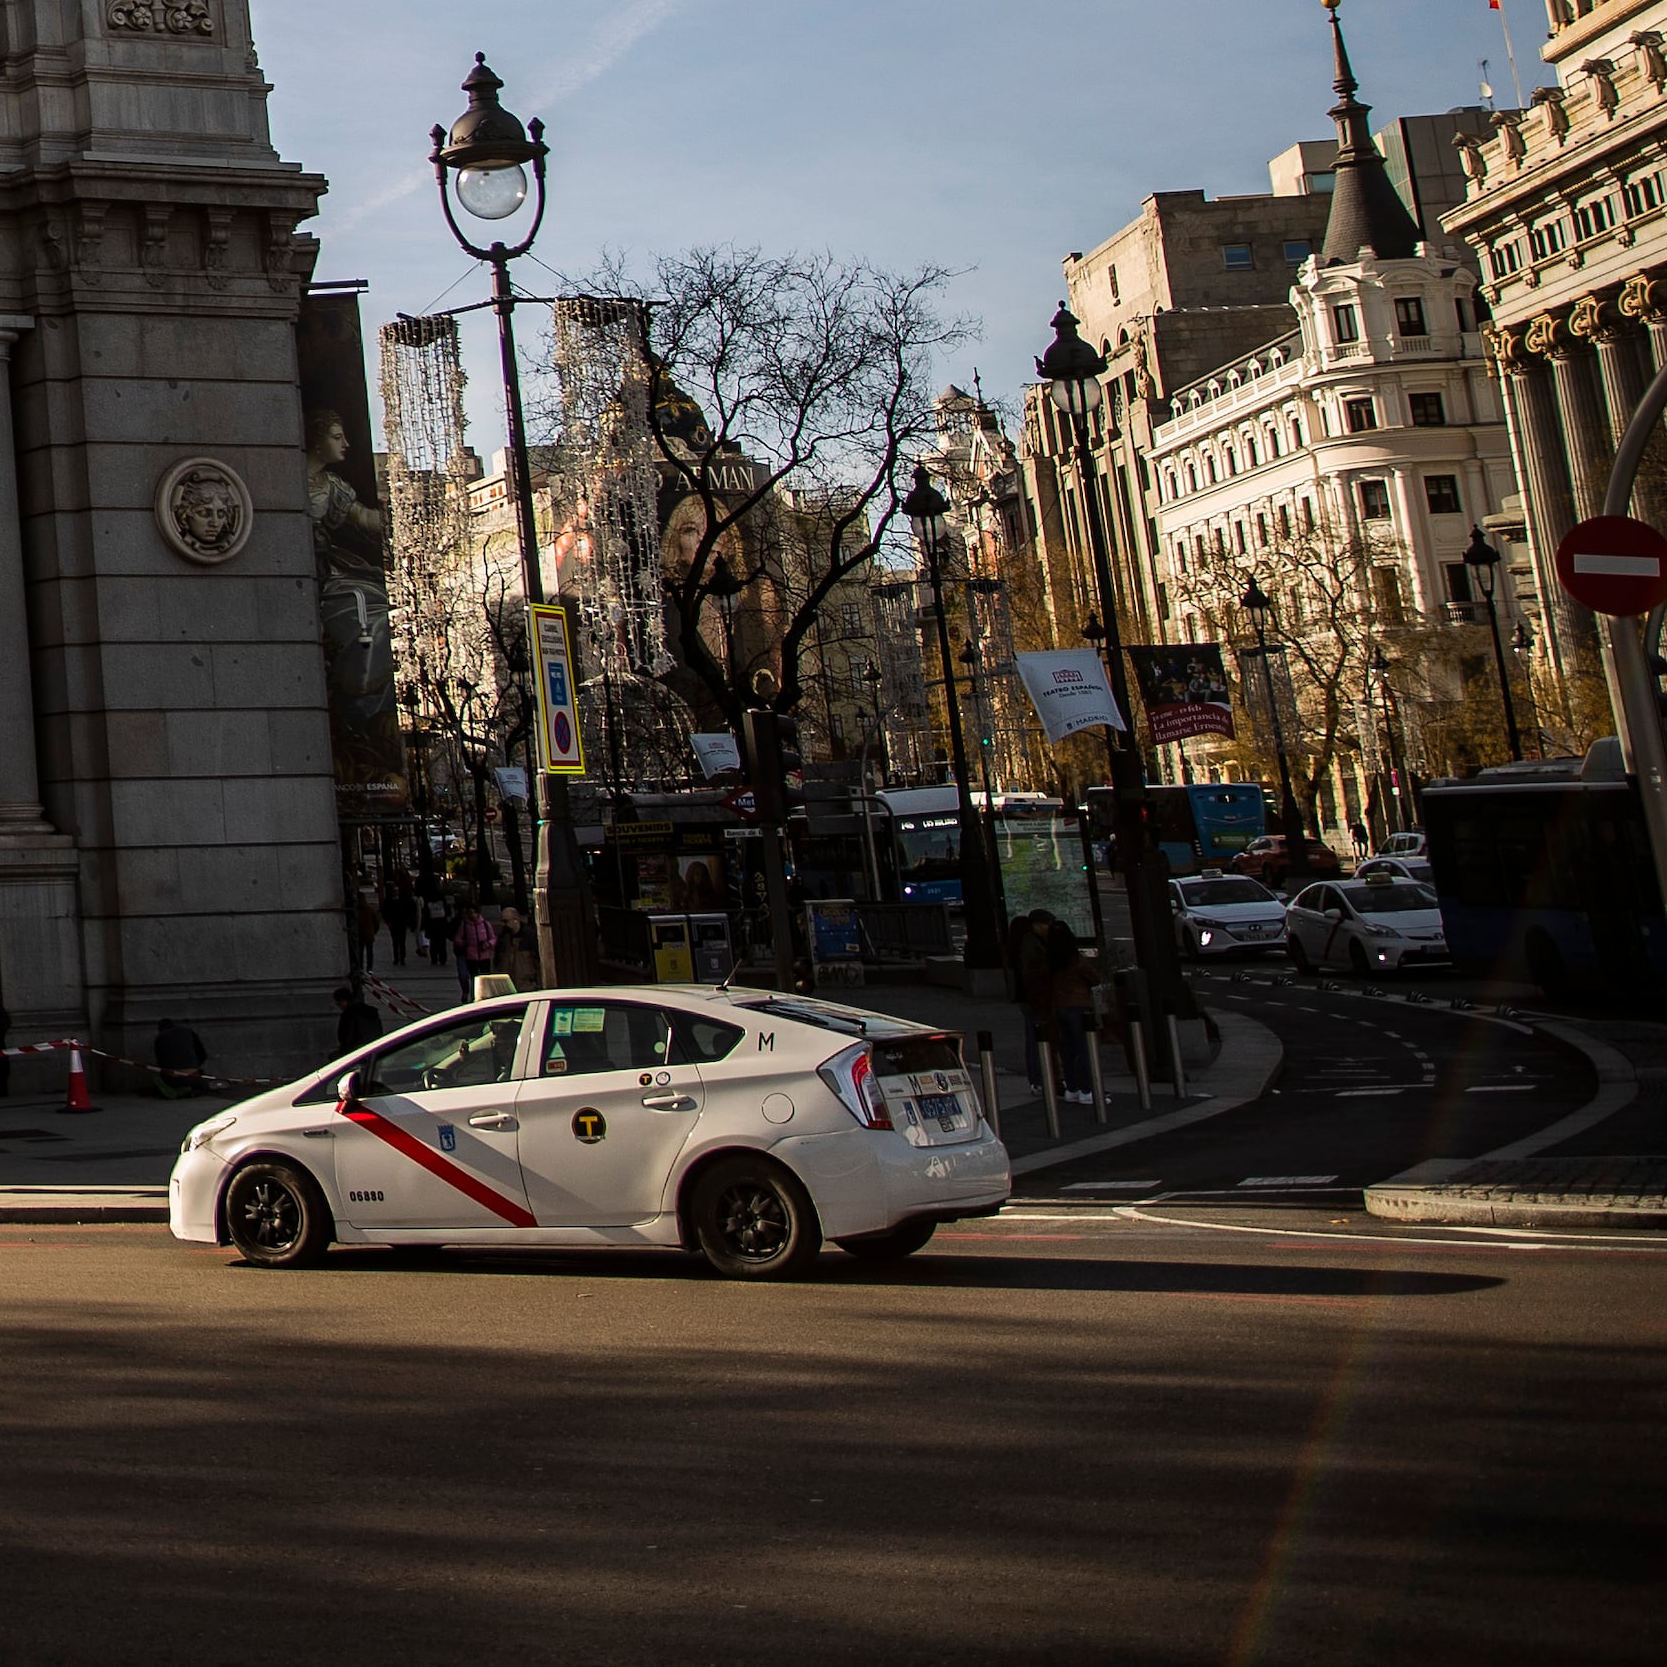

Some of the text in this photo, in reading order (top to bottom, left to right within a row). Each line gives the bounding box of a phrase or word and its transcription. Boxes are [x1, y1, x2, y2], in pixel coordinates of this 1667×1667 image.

[758, 1032, 774, 1051] M
[579, 1116, 598, 1137] T
[349, 1190, 384, 1202] 06880
